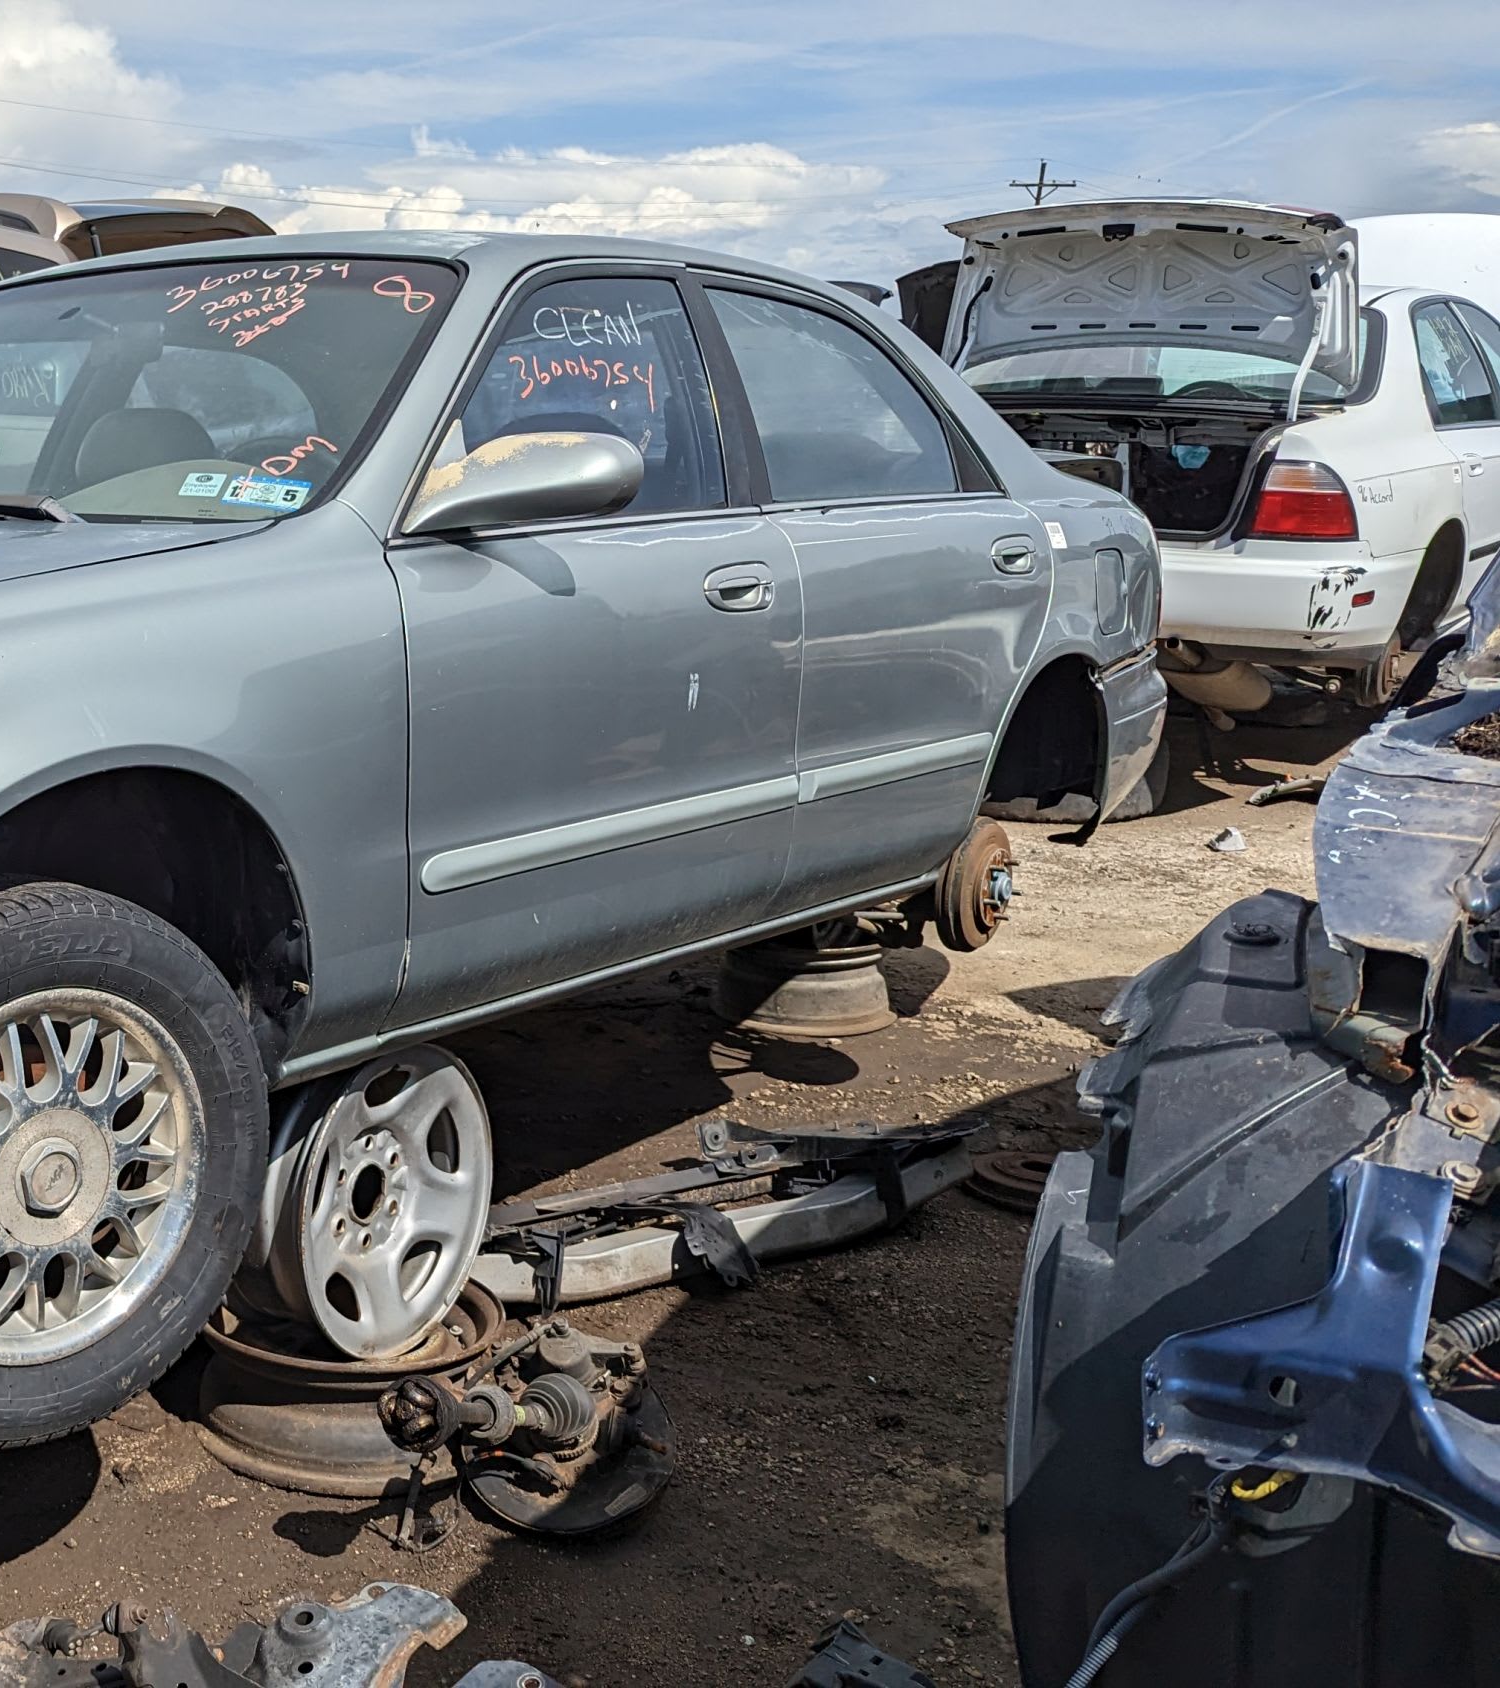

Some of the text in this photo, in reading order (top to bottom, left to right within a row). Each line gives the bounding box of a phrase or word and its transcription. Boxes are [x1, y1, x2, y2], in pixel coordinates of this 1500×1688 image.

[165, 262, 350, 314] 36006754
[532, 300, 642, 347] CLEAN
[508, 354, 655, 414] 36006754
[282, 489, 299, 502] 5
